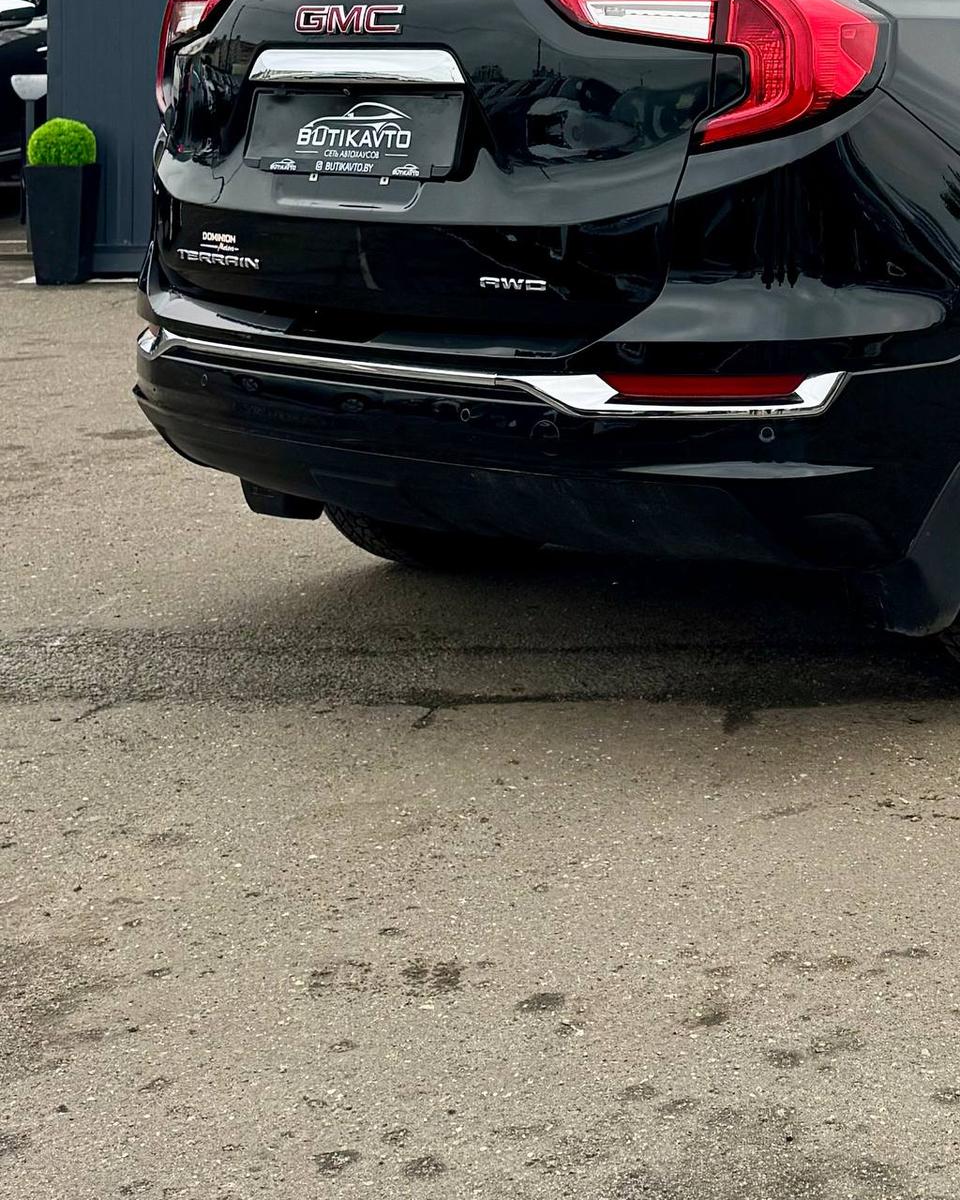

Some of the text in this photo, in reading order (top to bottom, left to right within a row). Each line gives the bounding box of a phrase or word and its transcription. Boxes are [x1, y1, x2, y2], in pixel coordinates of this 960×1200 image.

[294, 4, 404, 33] GMC
[296, 128, 412, 149] BUTIKAVTO
[325, 161, 374, 172] BUTIKAVTO.BY
[177, 248, 260, 269] TERRAIN
[479, 276, 547, 291] AWD
